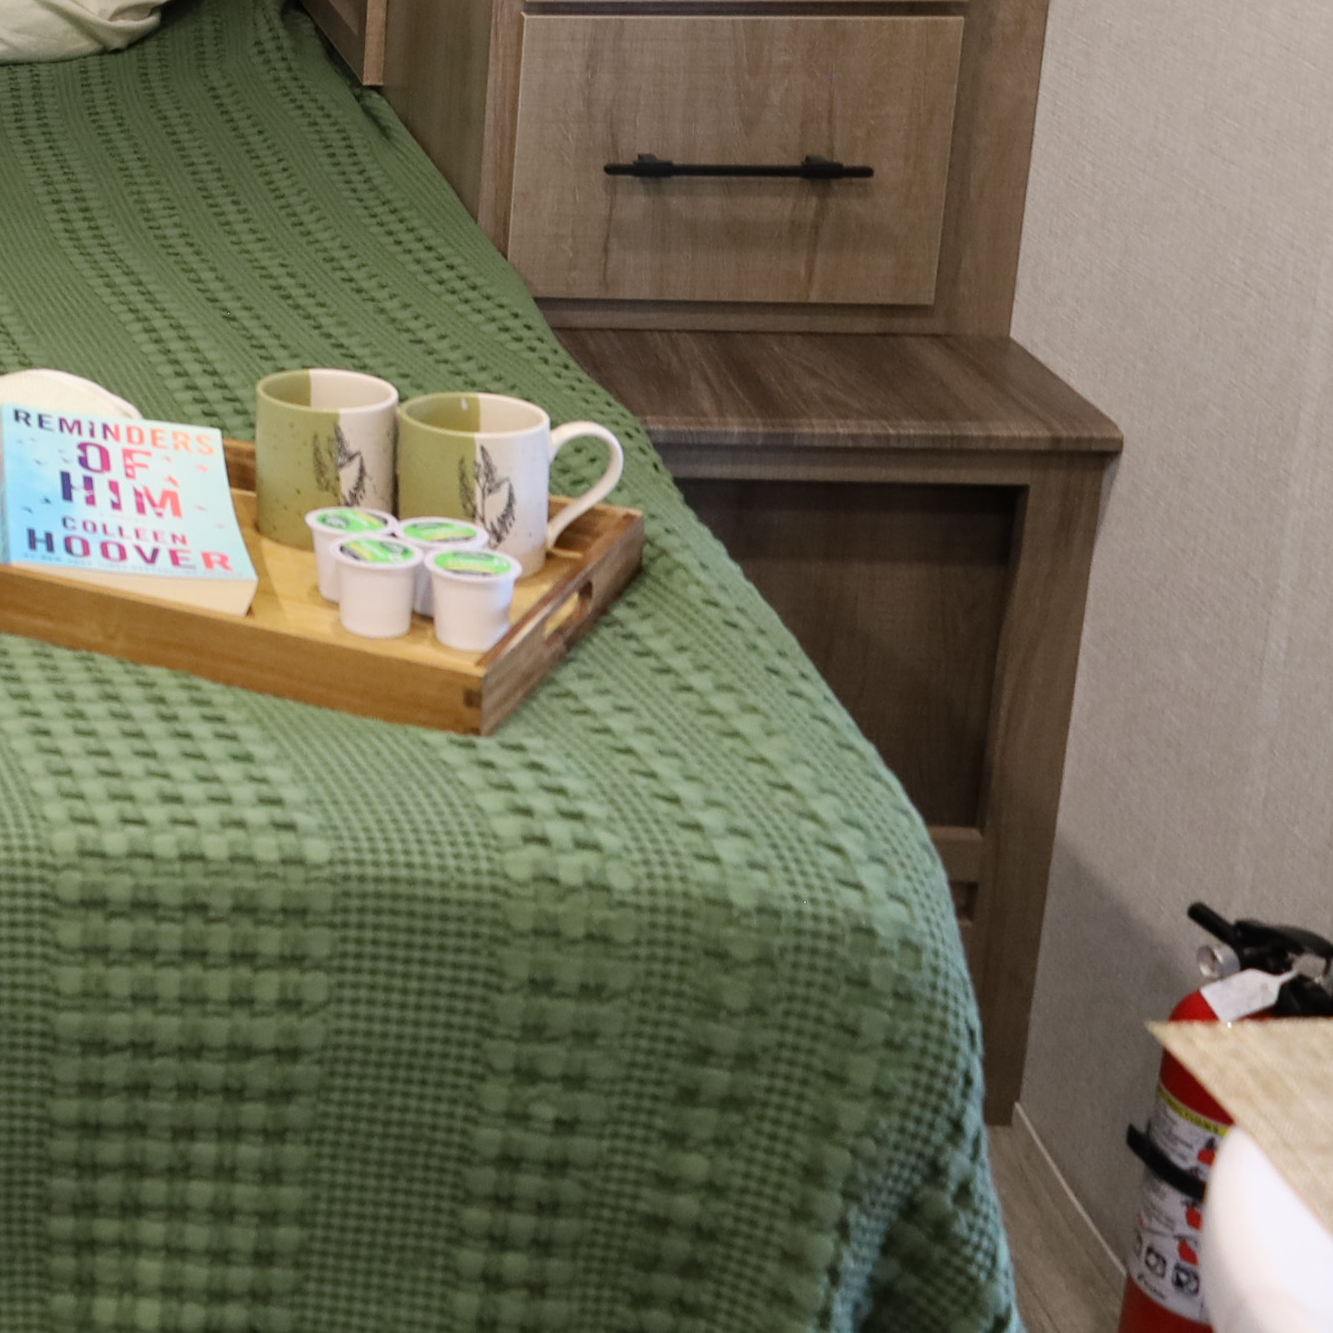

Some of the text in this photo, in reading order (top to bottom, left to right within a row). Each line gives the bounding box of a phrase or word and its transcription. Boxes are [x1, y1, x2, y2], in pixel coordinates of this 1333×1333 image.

[13, 408, 215, 456] REMINDERS
[77, 441, 152, 480] OF
[59, 470, 183, 519] HIM
[26, 528, 233, 572] HOOVER
[62, 516, 188, 546] COLLEEN
